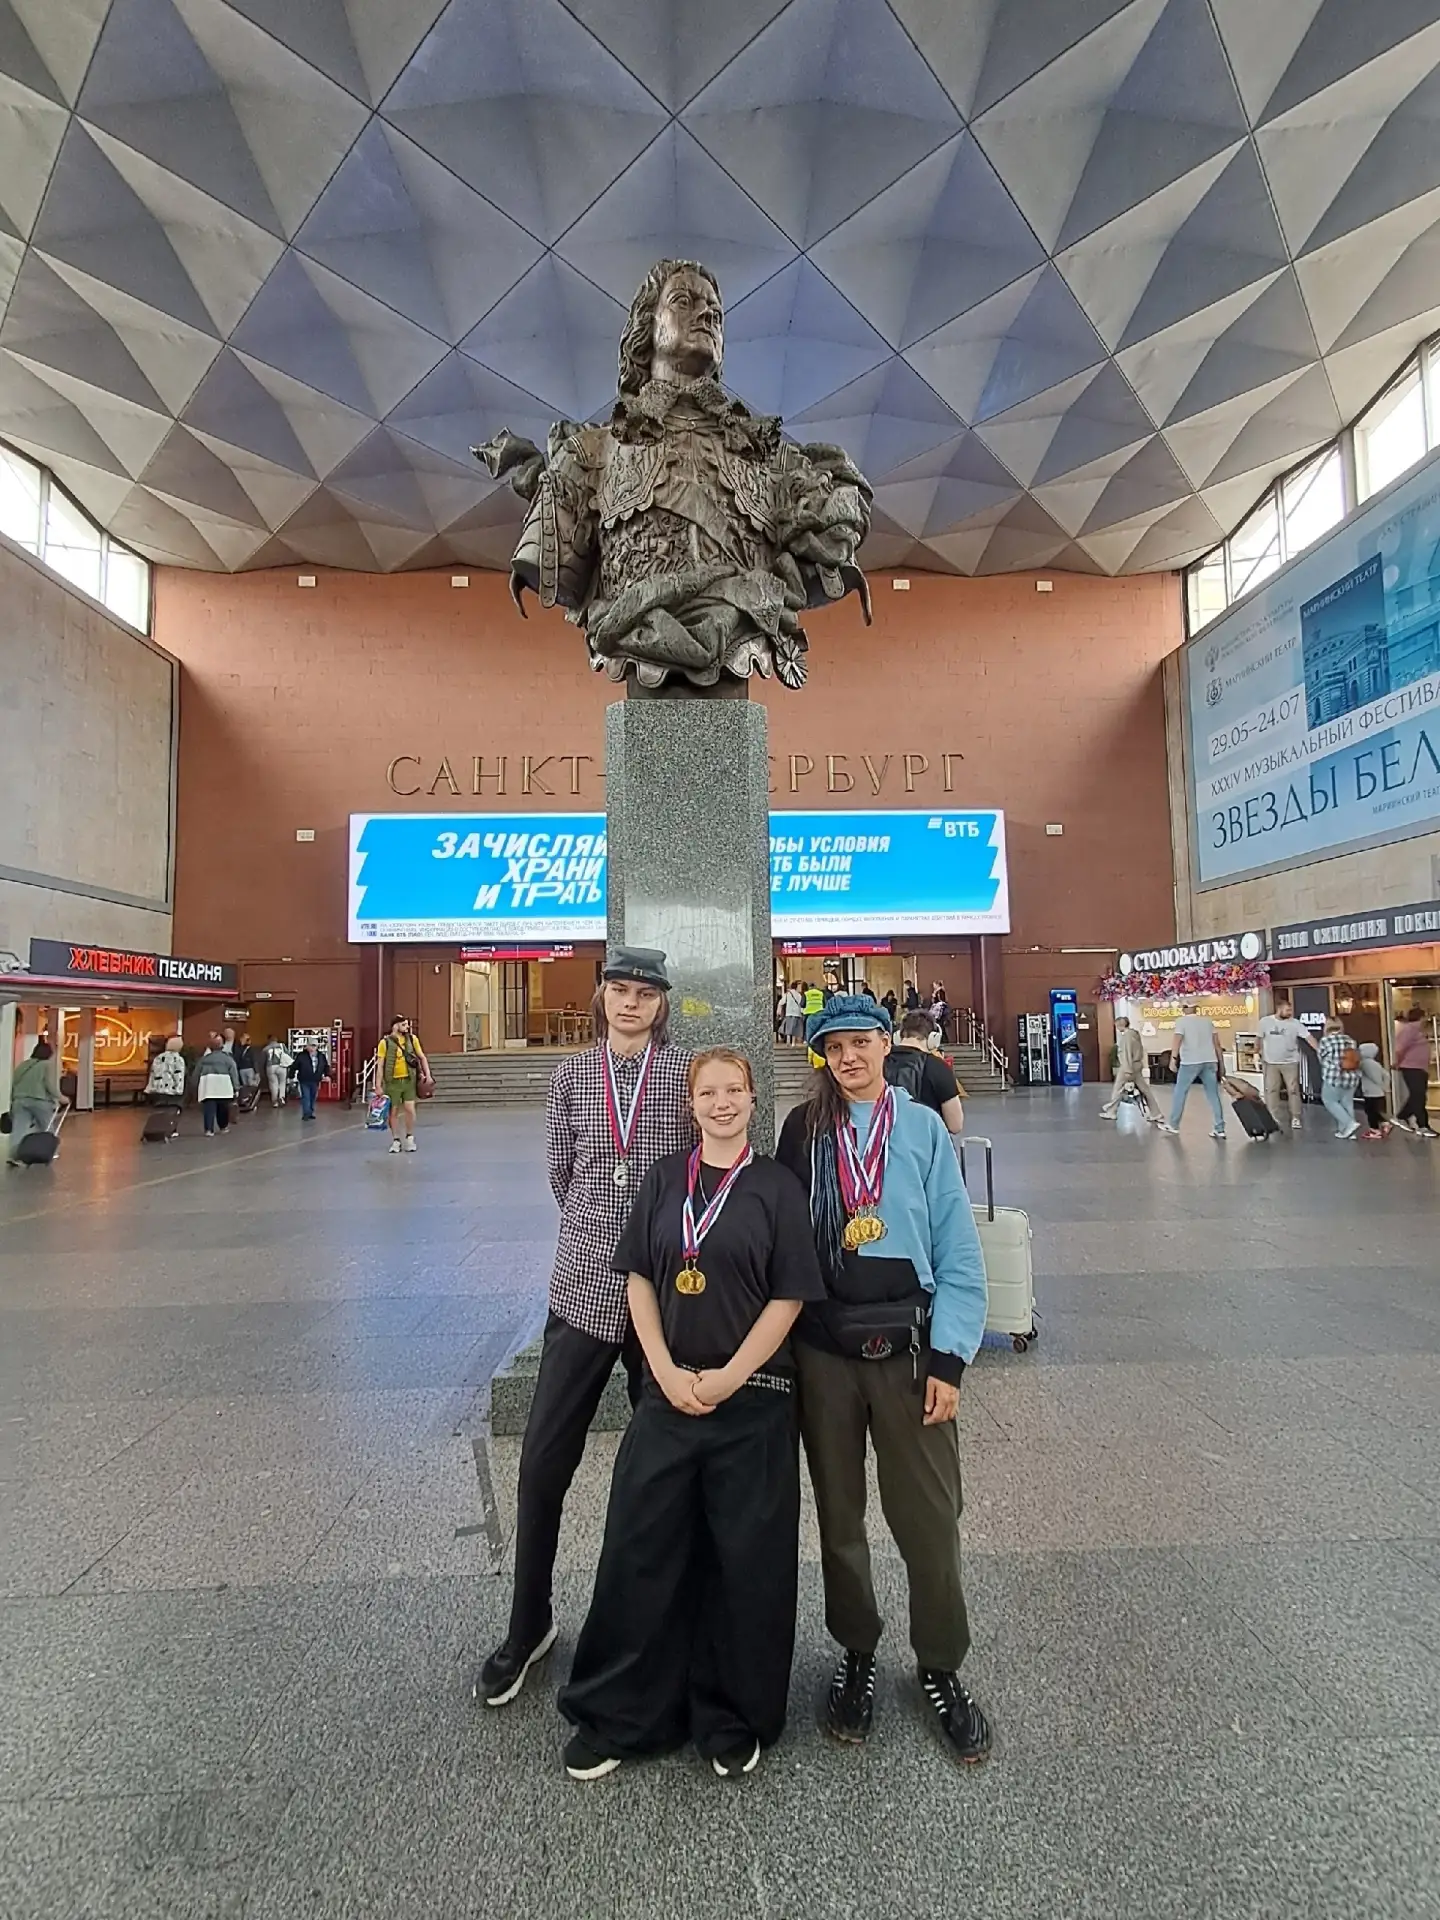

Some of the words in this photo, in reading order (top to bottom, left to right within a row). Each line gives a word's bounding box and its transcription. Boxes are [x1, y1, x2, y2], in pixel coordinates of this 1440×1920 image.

[1355, 563, 1378, 585] ТЕАТР
[1275, 637, 1297, 658] ТЕАТР
[1244, 717, 1354, 782] МУЗЫКАЛЬНЫЙ
[1212, 765, 1339, 849] ЗВЕЗДЫ
[1353, 729, 1440, 801] БЕЛ
[1372, 790, 1421, 815] МАРИИНСКИЙ
[944, 821, 980, 837] ВТБ
[431, 830, 607, 859] ЗАЧИСЛЯЙ
[810, 836, 890, 853] УСЛОВИЯ
[500, 857, 605, 883] ХРАНИ
[798, 855, 852, 872] БЫЛИ
[473, 884, 502, 909] И
[510, 880, 602, 908] ТРАТЬ
[787, 874, 852, 891] ЛУЧШЕ
[1278, 931, 1309, 950] ЗОНА
[1313, 918, 1387, 944] ОЖИДАНИЯ
[1394, 909, 1440, 935] ПОВЫ
[68, 947, 156, 976] ХЛЕБНИК
[158, 959, 222, 982] ПЕКАРНЯ
[1134, 943, 1210, 971] СТОЛОВАЯ
